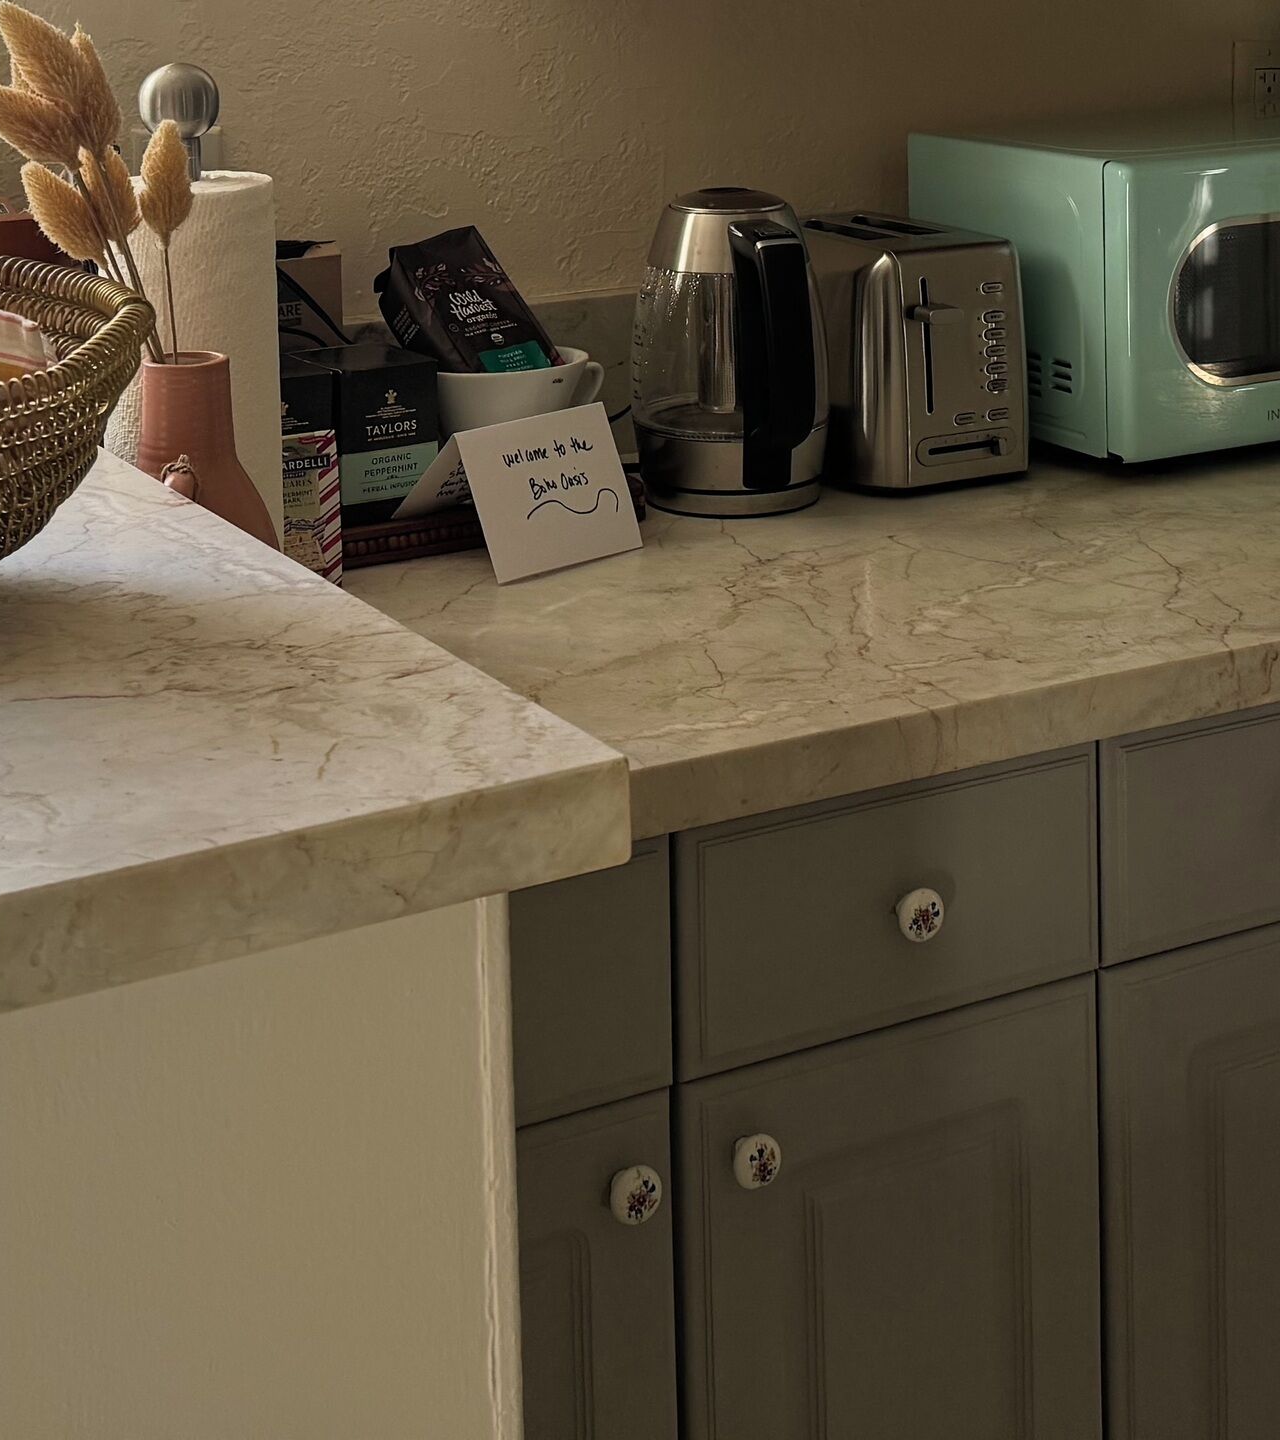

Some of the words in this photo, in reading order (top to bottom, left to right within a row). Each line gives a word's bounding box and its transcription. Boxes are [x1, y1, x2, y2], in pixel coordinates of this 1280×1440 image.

[449, 289, 484, 305] Wild
[450, 299, 498, 321] Harvest
[365, 420, 417, 437] TAYLORS
[553, 439, 566, 458] to
[570, 436, 594, 453] the
[283, 457, 327, 471] ARDELLI
[371, 452, 412, 466] ORGANIC
[364, 462, 419, 478] PEPPERMINT
